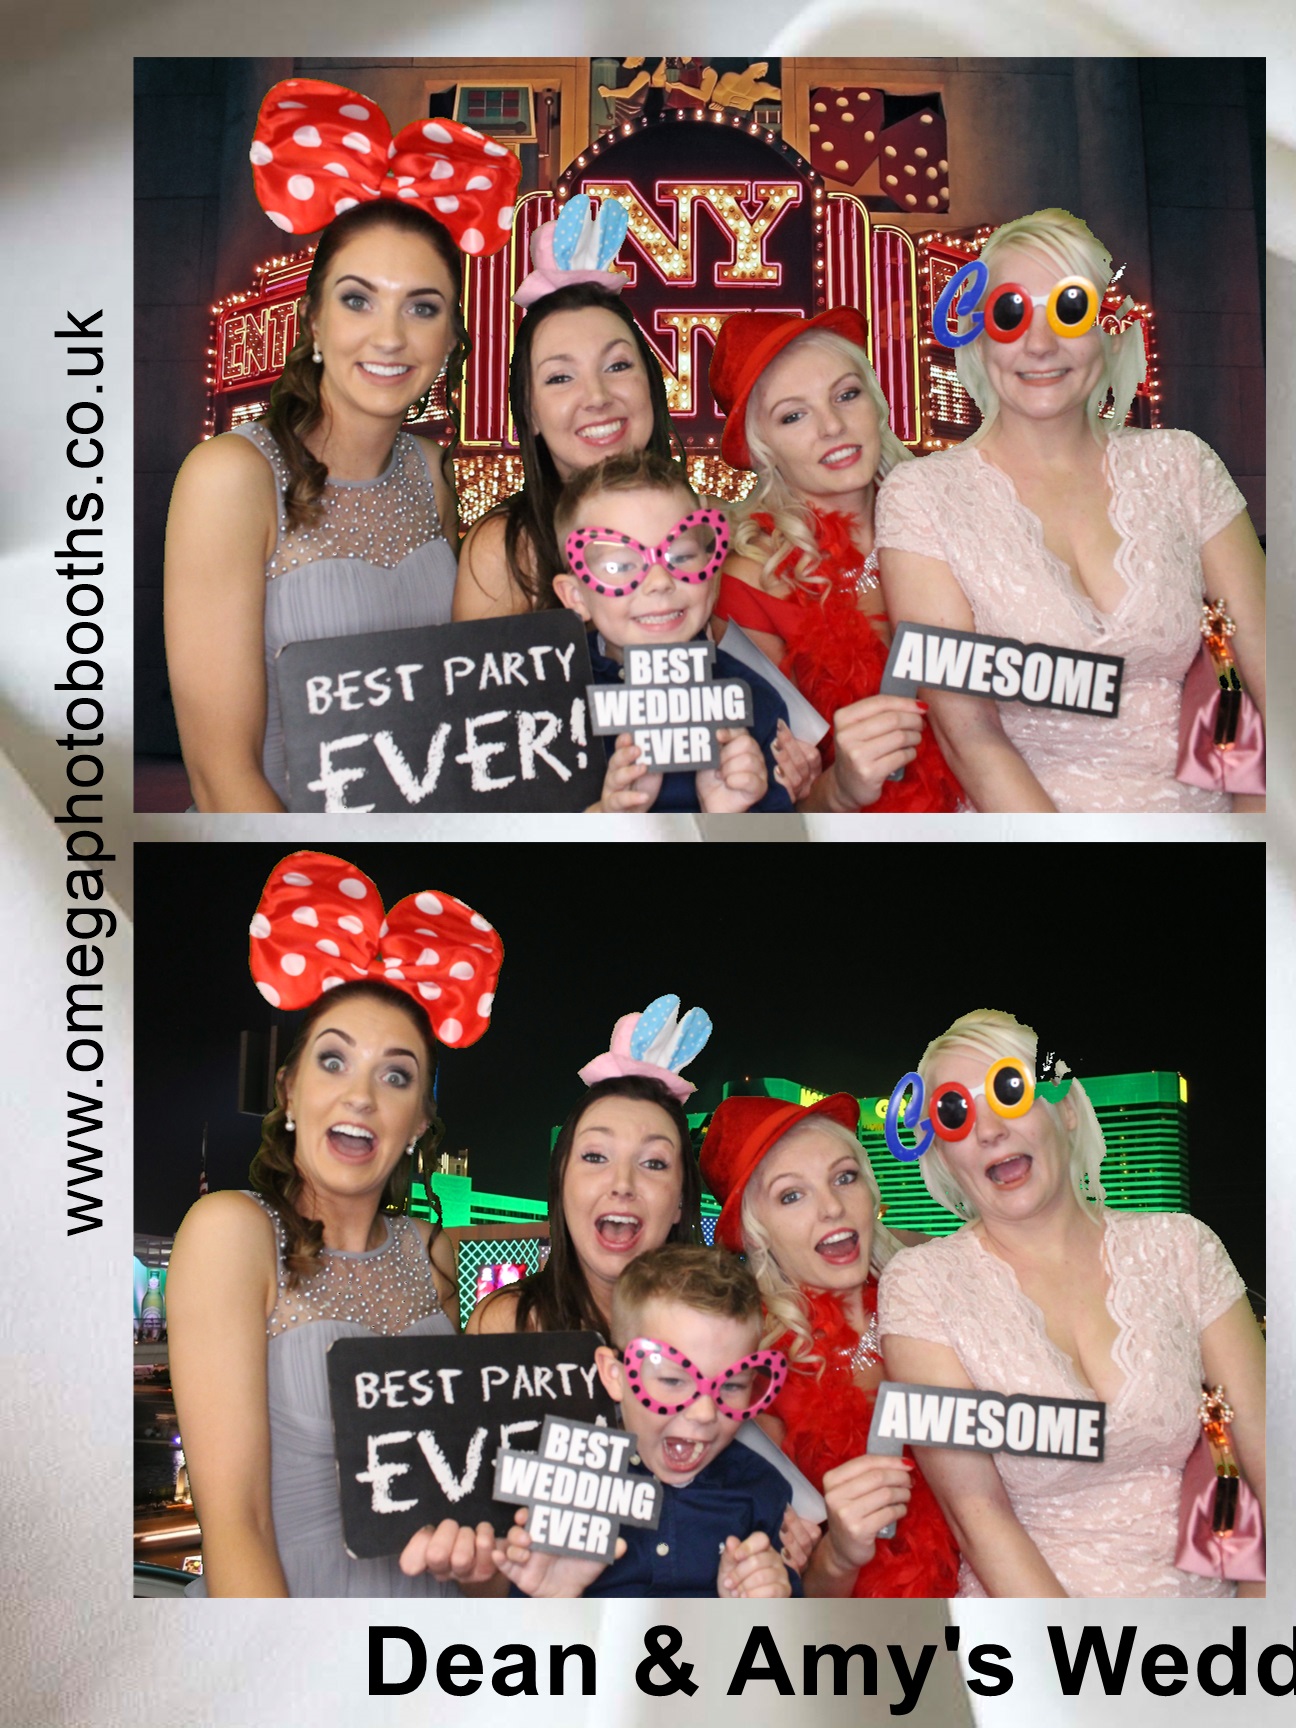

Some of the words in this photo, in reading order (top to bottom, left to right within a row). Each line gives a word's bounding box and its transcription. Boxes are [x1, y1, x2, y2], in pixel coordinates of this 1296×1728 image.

[582, 180, 802, 287] NY
[306, 664, 424, 715] BEST
[443, 642, 575, 696] PARTY
[630, 647, 708, 684] BEST
[891, 631, 1118, 713] AWESOME
[594, 684, 746, 727] WEDDING
[307, 697, 587, 813] EVER!
[634, 727, 712, 766] EVER
[355, 1368, 463, 1409] BEST
[481, 1362, 598, 1401] PARTY
[544, 1423, 630, 1472] BEST
[877, 1391, 1101, 1457] AWESOME
[500, 1455, 657, 1521] WEDDING
[529, 1506, 612, 1554] EVER
